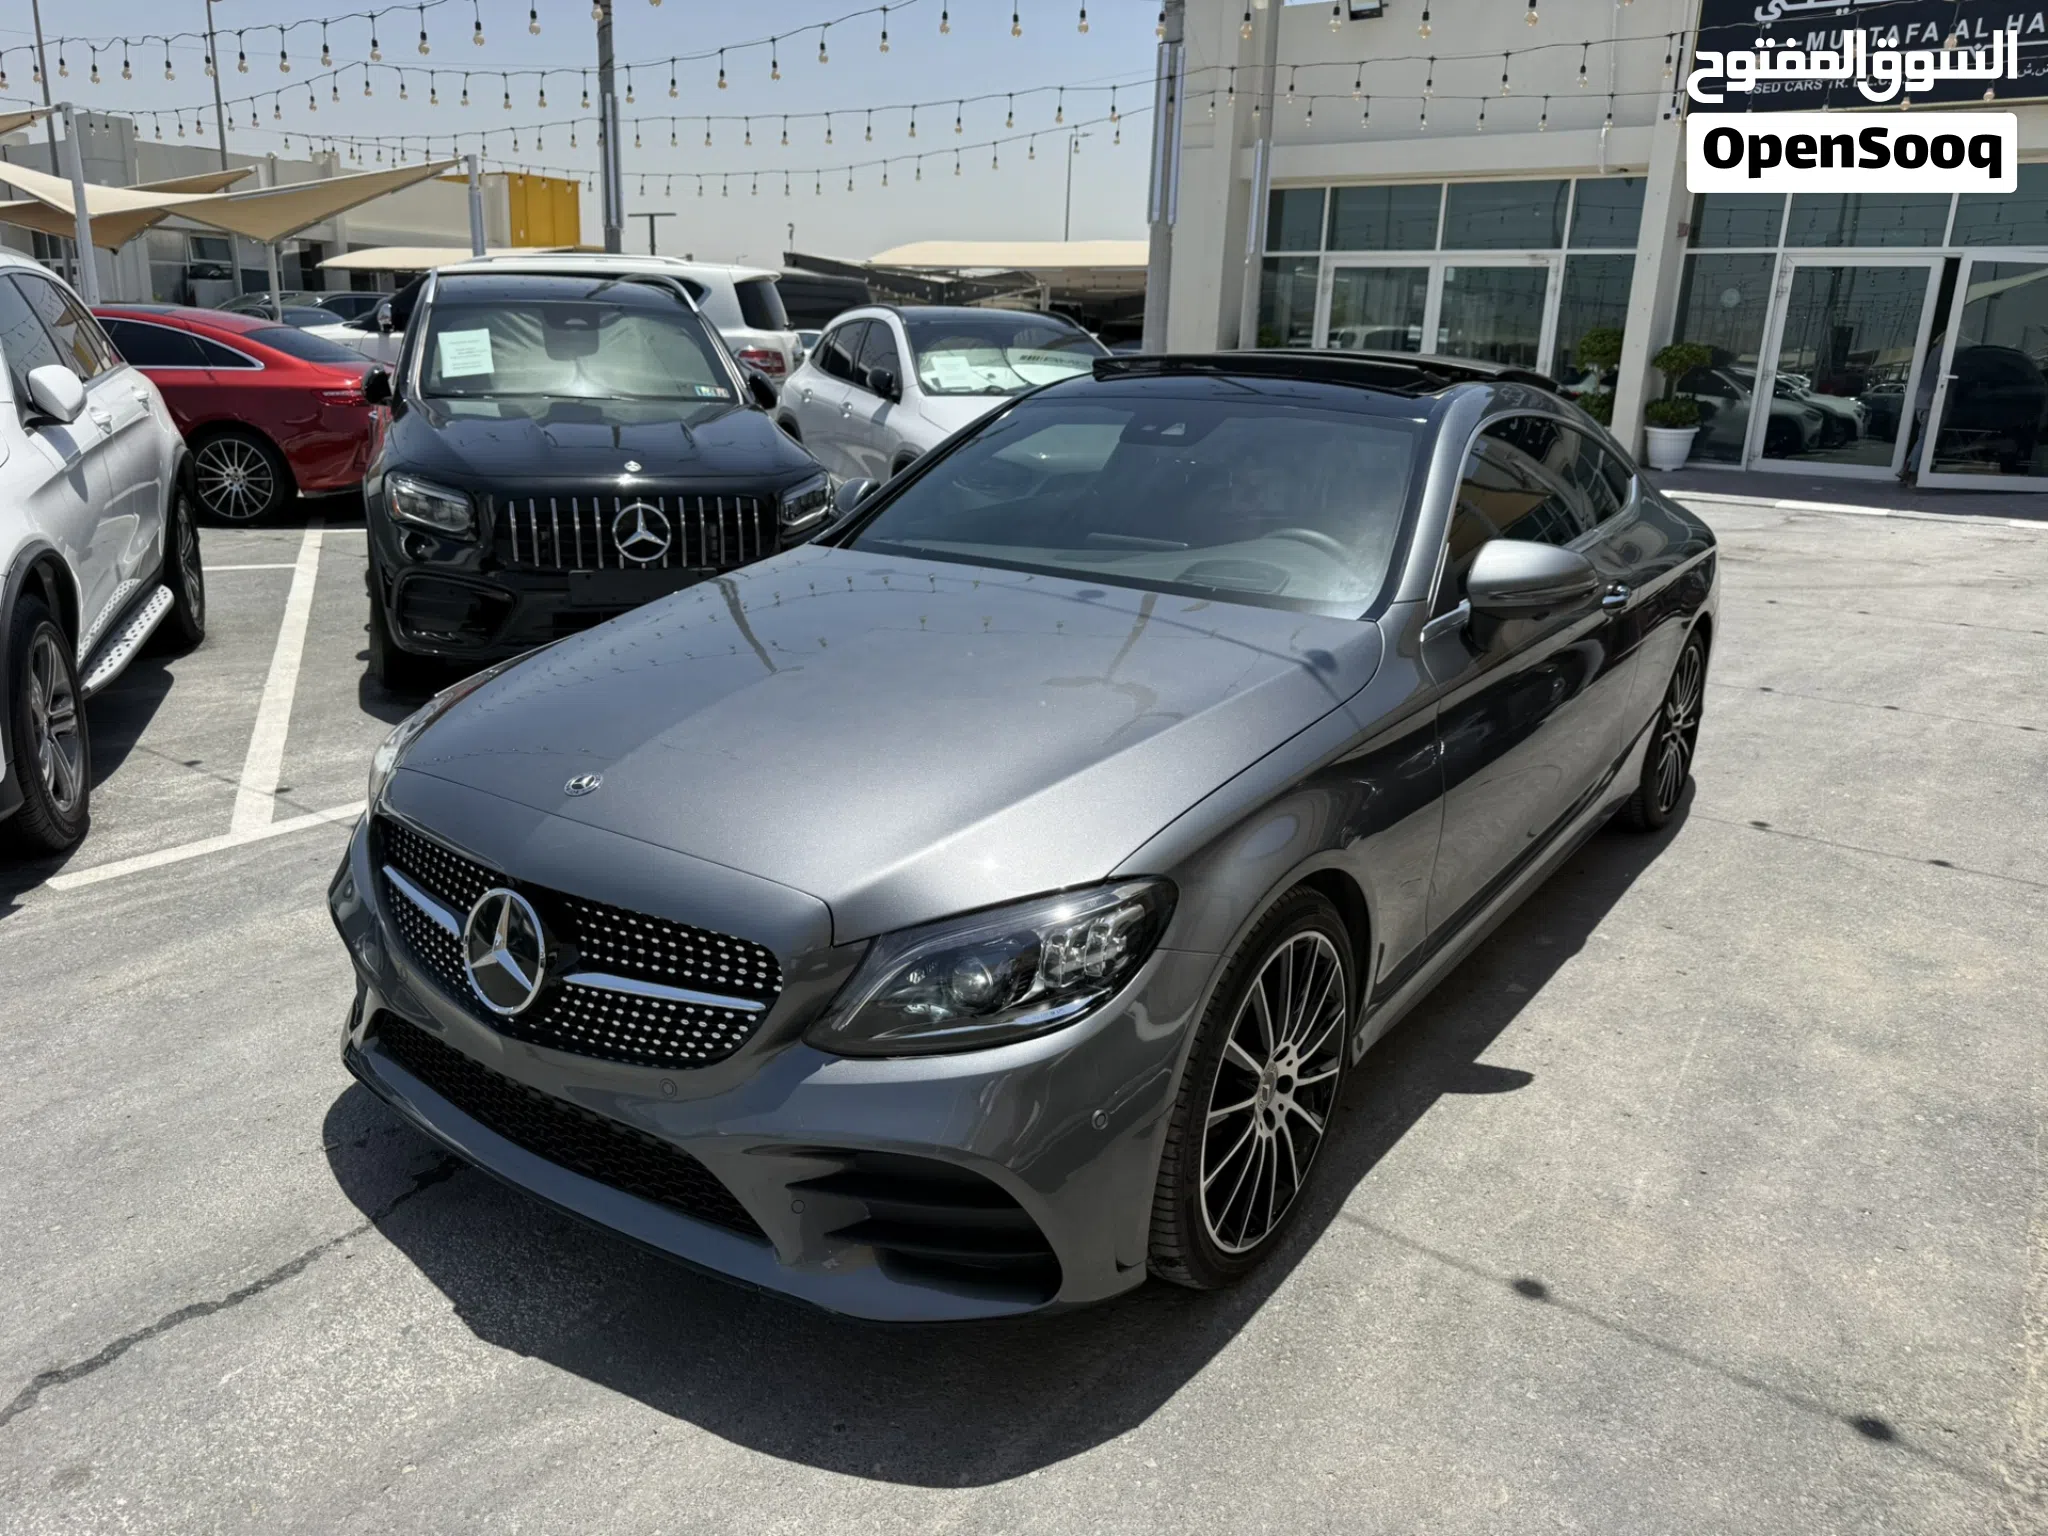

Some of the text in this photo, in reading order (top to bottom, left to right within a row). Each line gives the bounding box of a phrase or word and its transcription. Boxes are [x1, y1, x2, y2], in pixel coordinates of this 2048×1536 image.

[1806, 21, 1939, 51] MUTAFA
[1954, 17, 1989, 40] AL
[1745, 81, 1781, 95] SED
[1784, 78, 1823, 92] CARS
